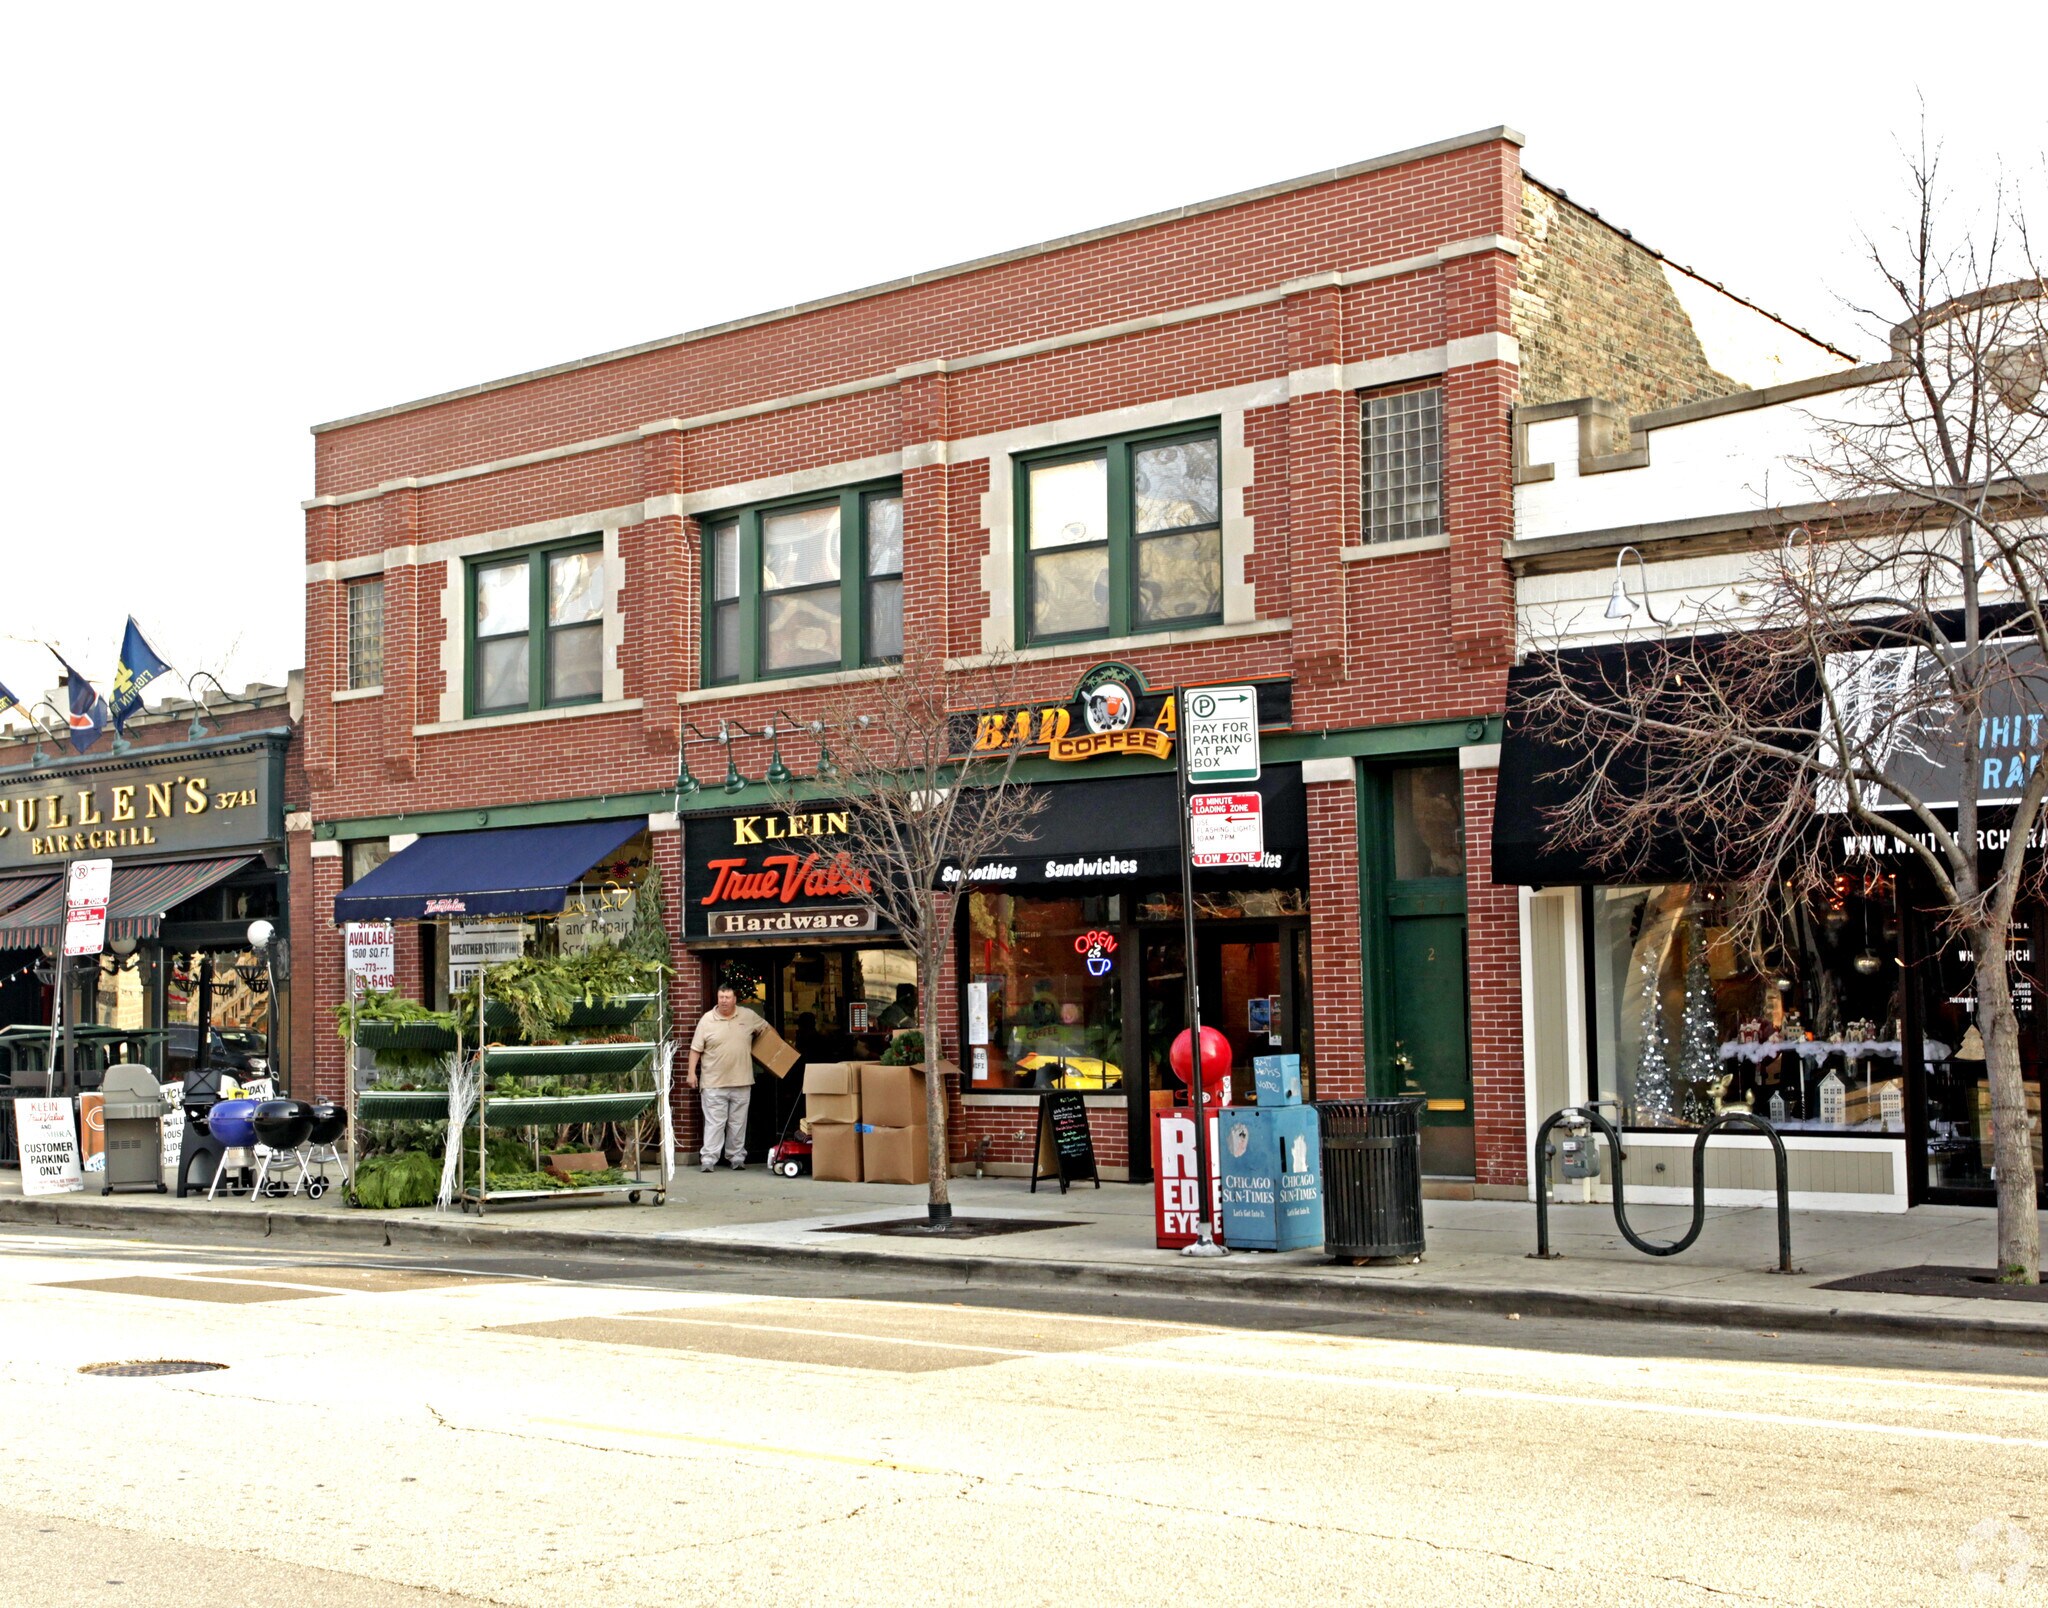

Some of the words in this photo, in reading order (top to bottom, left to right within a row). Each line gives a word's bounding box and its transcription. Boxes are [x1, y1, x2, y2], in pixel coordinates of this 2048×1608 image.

[975, 708, 1071, 751] BAD
[1193, 724, 1218, 734] PAY
[1222, 722, 1248, 732] FOR
[1058, 732, 1158, 756] COFFEE
[1193, 733, 1252, 745] PARKING
[1195, 747, 1211, 756] AT
[1216, 745, 1240, 755] PAY
[1194, 757, 1221, 767] BOX
[214, 788, 258, 810] 3741
[1195, 798, 1204, 806] 15
[1206, 797, 1233, 805] MINUTE
[1195, 805, 1227, 814] LOADING
[1229, 804, 1249, 812] ZONE
[732, 811, 849, 846] KLEIN
[1196, 826, 1230, 834] FLASHING
[1233, 824, 1257, 832] LIGHTS
[1197, 854, 1221, 864] TOW
[1226, 852, 1256, 863] ZONE
[1045, 856, 1138, 878] Sandwiches
[700, 858, 780, 906] True
[724, 912, 860, 933] Hardware
[348, 931, 394, 946] AVAILABLE
[1075, 930, 1118, 953] OPEN
[352, 949, 366, 958] 1500
[451, 943, 483, 955] WEATHER
[1026, 1027, 1057, 1040] COFFEE
[31, 1102, 58, 1112] KLEIN
[24, 1142, 73, 1153] CUSTOMER
[30, 1154, 70, 1164] PARKING
[40, 1166, 62, 1176] ONLY
[1225, 1175, 1271, 1189] CHICAGO
[1282, 1174, 1315, 1188] CHICAGO
[1223, 1189, 1275, 1204] SUN-TIMES
[1280, 1188, 1317, 1203] SUN-TIMES
